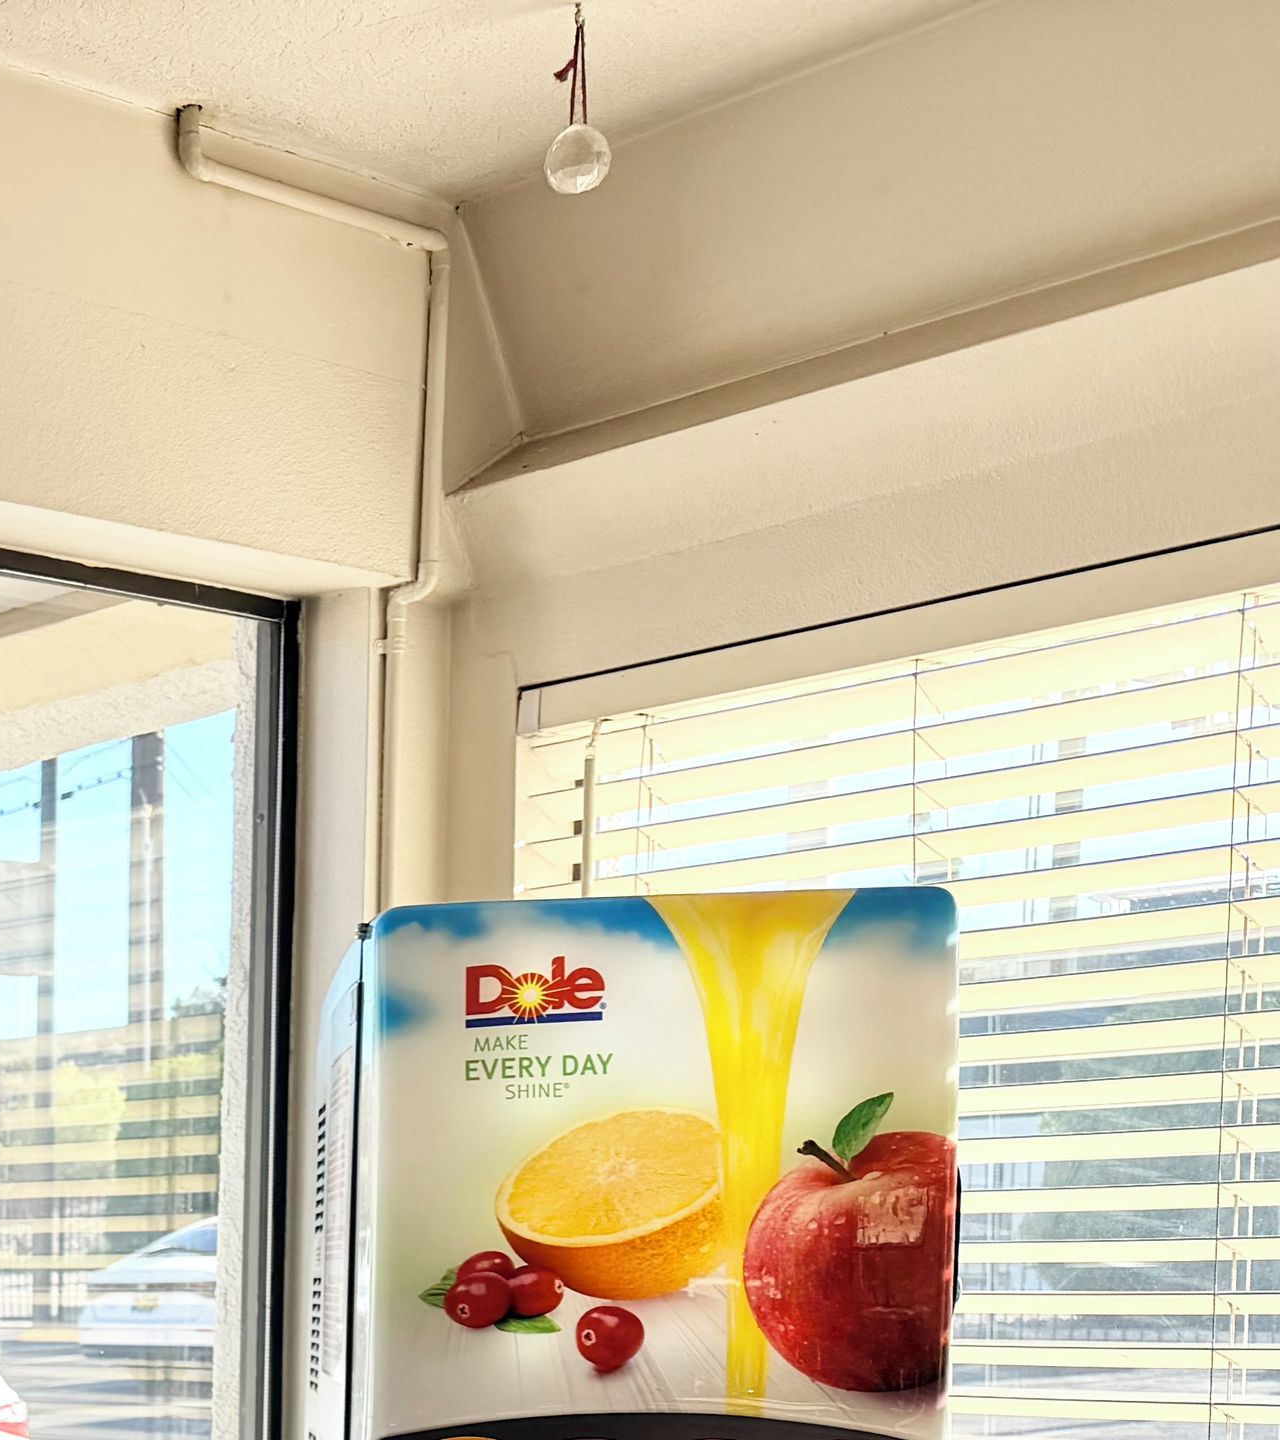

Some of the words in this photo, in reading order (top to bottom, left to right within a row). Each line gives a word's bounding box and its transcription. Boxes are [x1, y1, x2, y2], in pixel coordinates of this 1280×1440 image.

[466, 956, 606, 1018] Dole
[474, 1034, 529, 1053] MAKE
[465, 1056, 553, 1082] EVERY
[562, 1053, 614, 1077] DAY
